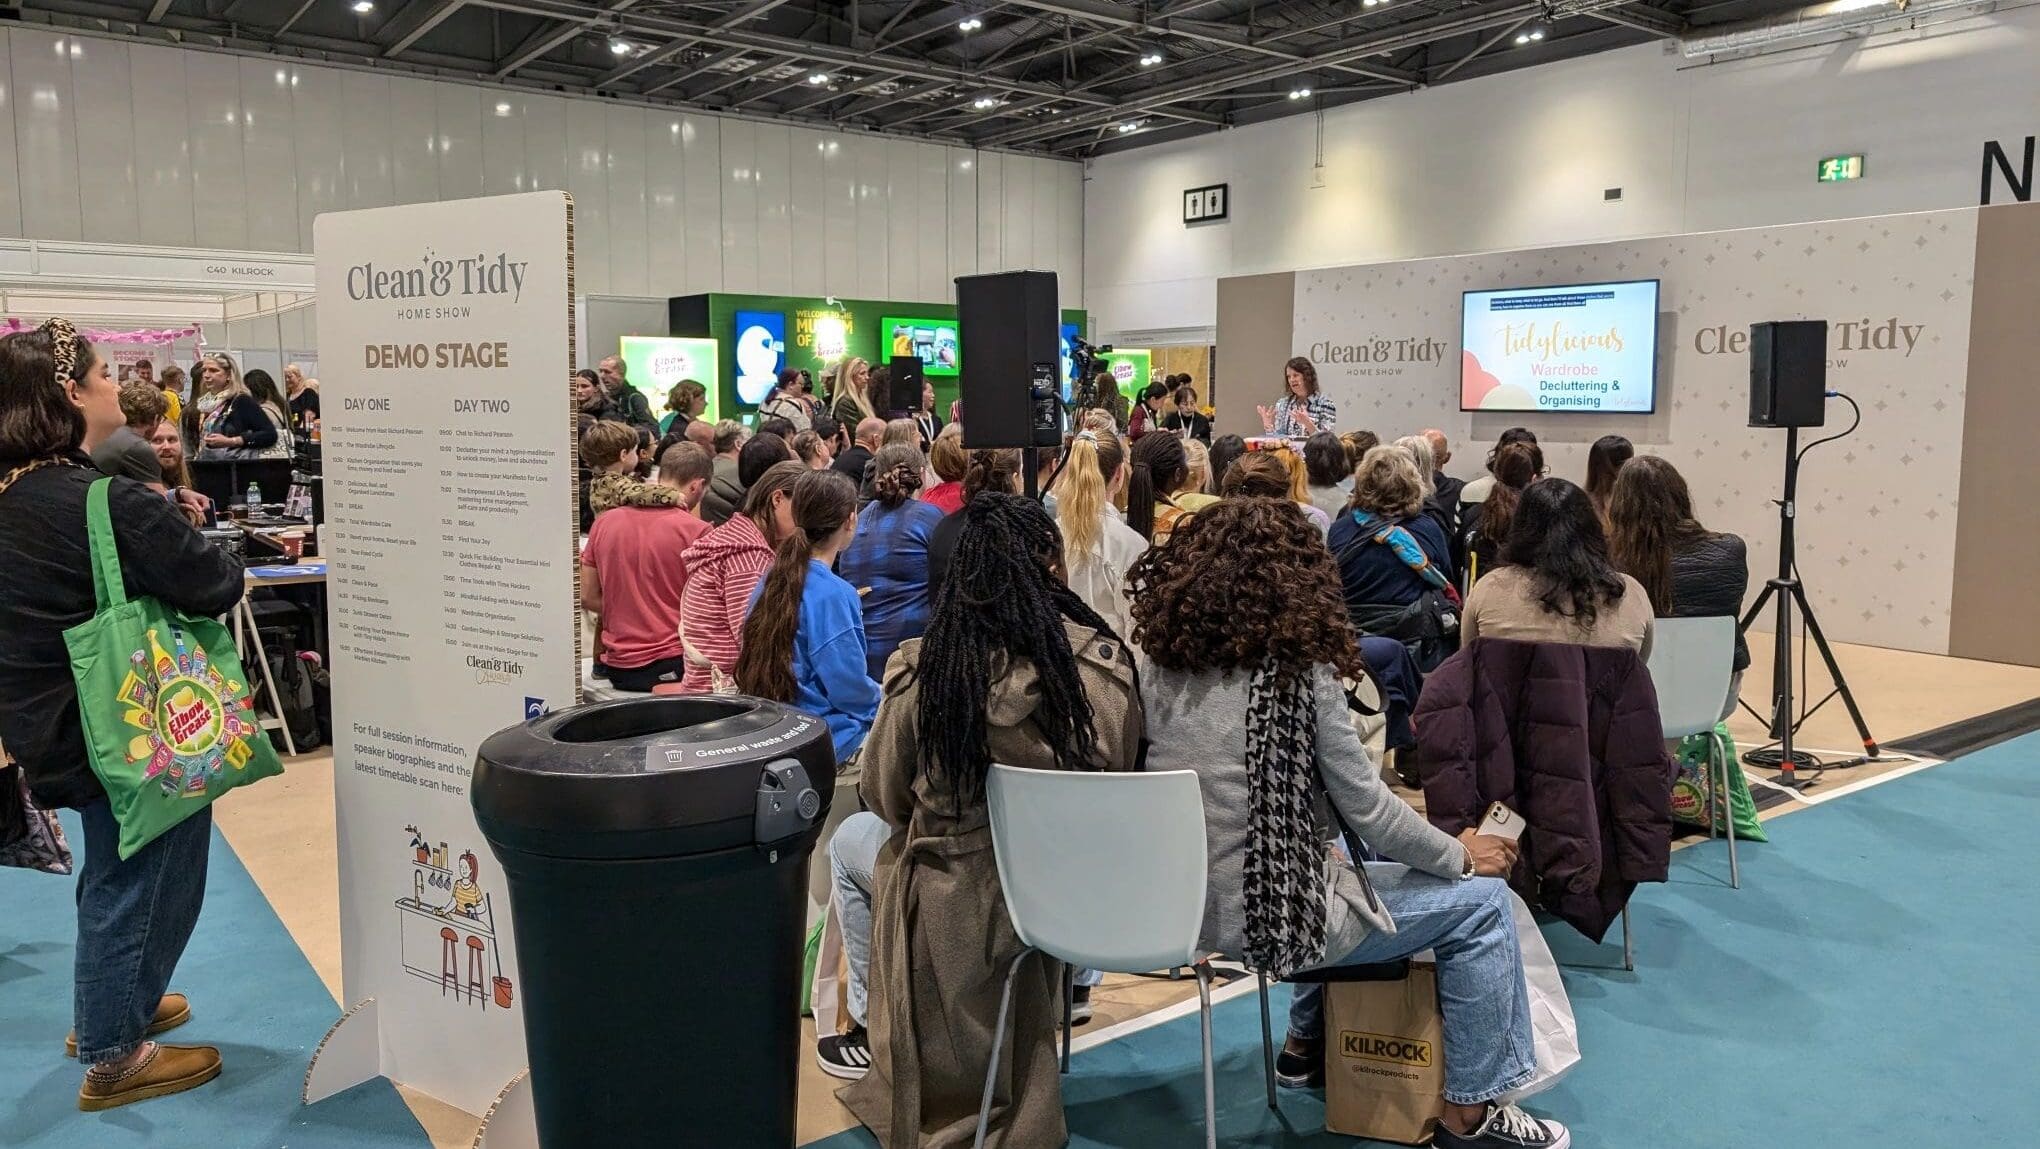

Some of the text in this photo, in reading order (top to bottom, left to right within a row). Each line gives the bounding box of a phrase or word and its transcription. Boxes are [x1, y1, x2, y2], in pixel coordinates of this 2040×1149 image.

[1980, 136, 2036, 205] N
[231, 267, 274, 276] KILROCK
[347, 253, 528, 304] Clean & Tidy
[398, 306, 471, 320] HOME SHOW
[796, 318, 853, 335] MUM
[796, 334, 812, 347] OF
[1496, 320, 1624, 361] tidylicious
[1694, 318, 1926, 358] Cle Tidy
[365, 342, 508, 368] DEMO STAGE
[1311, 337, 1448, 367] Clean & Tidy
[1375, 368, 1403, 376] SHOW
[1532, 363, 1598, 376] Wardrobe
[1540, 380, 1620, 393] Decluttering &
[344, 398, 390, 410] DAY ONE
[454, 400, 510, 413] DAY TWO
[1539, 395, 1600, 408] Organising
[489, 506, 518, 514] productivity
[483, 555, 503, 564] Building
[516, 558, 538, 566] Essential
[510, 582, 530, 590] Hackers
[480, 595, 497, 604] Folding
[524, 601, 542, 609] Kondo
[461, 609, 484, 617] Wardrobe
[461, 625, 478, 633] Garden
[480, 628, 496, 636] Design
[501, 631, 520, 639] Storage
[521, 633, 544, 642] Solutions
[506, 648, 520, 656] Stage
[467, 655, 524, 678] Clean & Tidy
[168, 697, 204, 734] Elbow
[174, 709, 211, 744] Grease
[354, 723, 467, 758] For full session information,
[696, 744, 750, 757] General
[750, 736, 784, 749] waste
[354, 743, 471, 777] speaker biographies and the
[355, 760, 464, 796] latest timetable scan here:
[1345, 1036, 1426, 1062] KILROCK
[1352, 1064, 1419, 1080] @kilrockproducts
